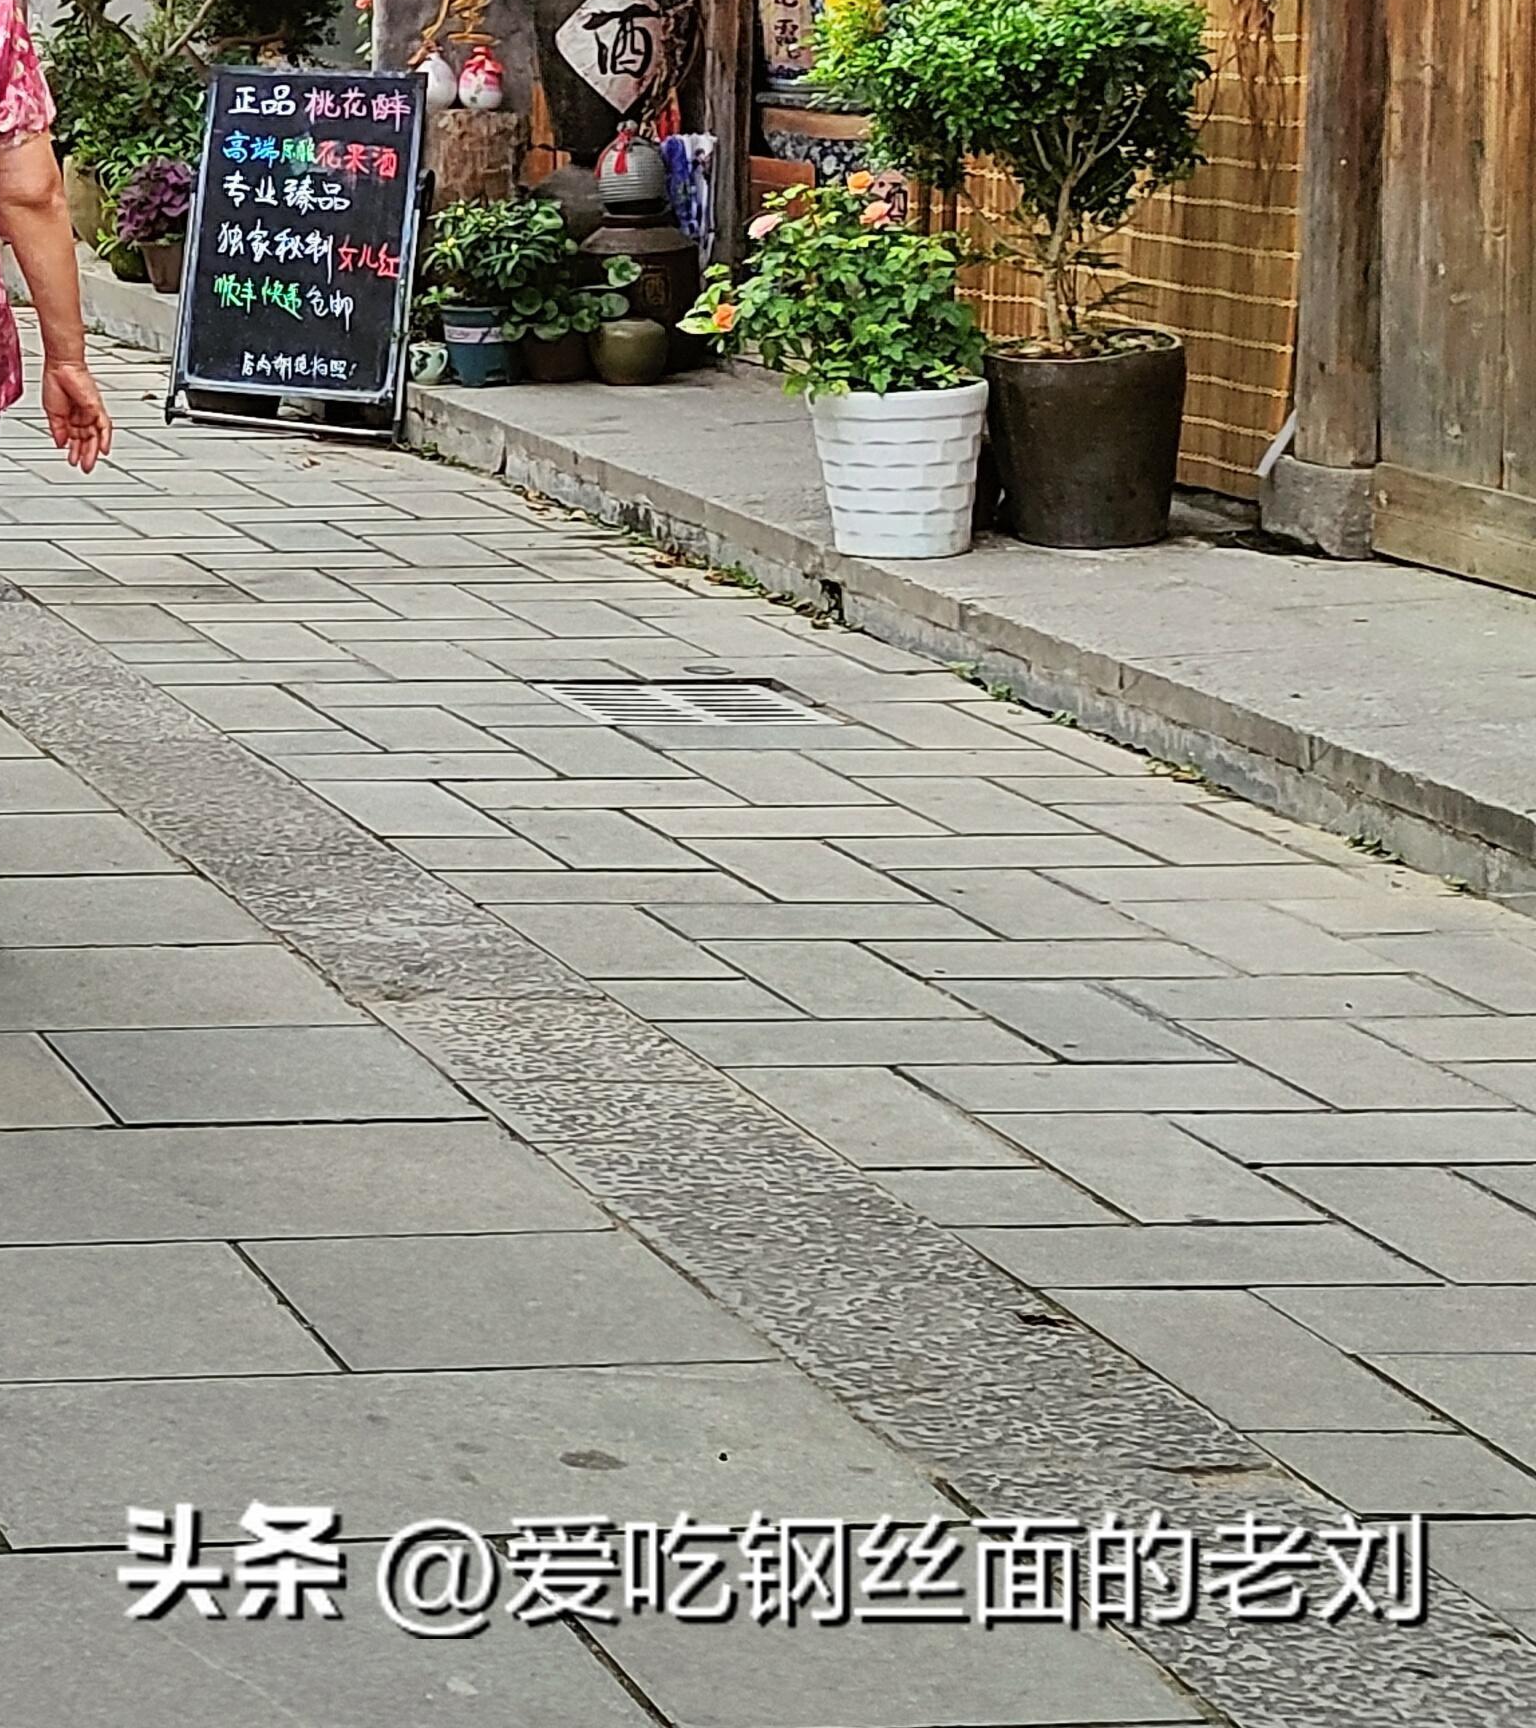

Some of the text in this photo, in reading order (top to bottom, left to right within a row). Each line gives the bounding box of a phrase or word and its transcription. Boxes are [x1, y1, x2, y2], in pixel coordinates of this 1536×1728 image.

[582, 2, 664, 75] 酒
[222, 169, 352, 216] 专业臻品
